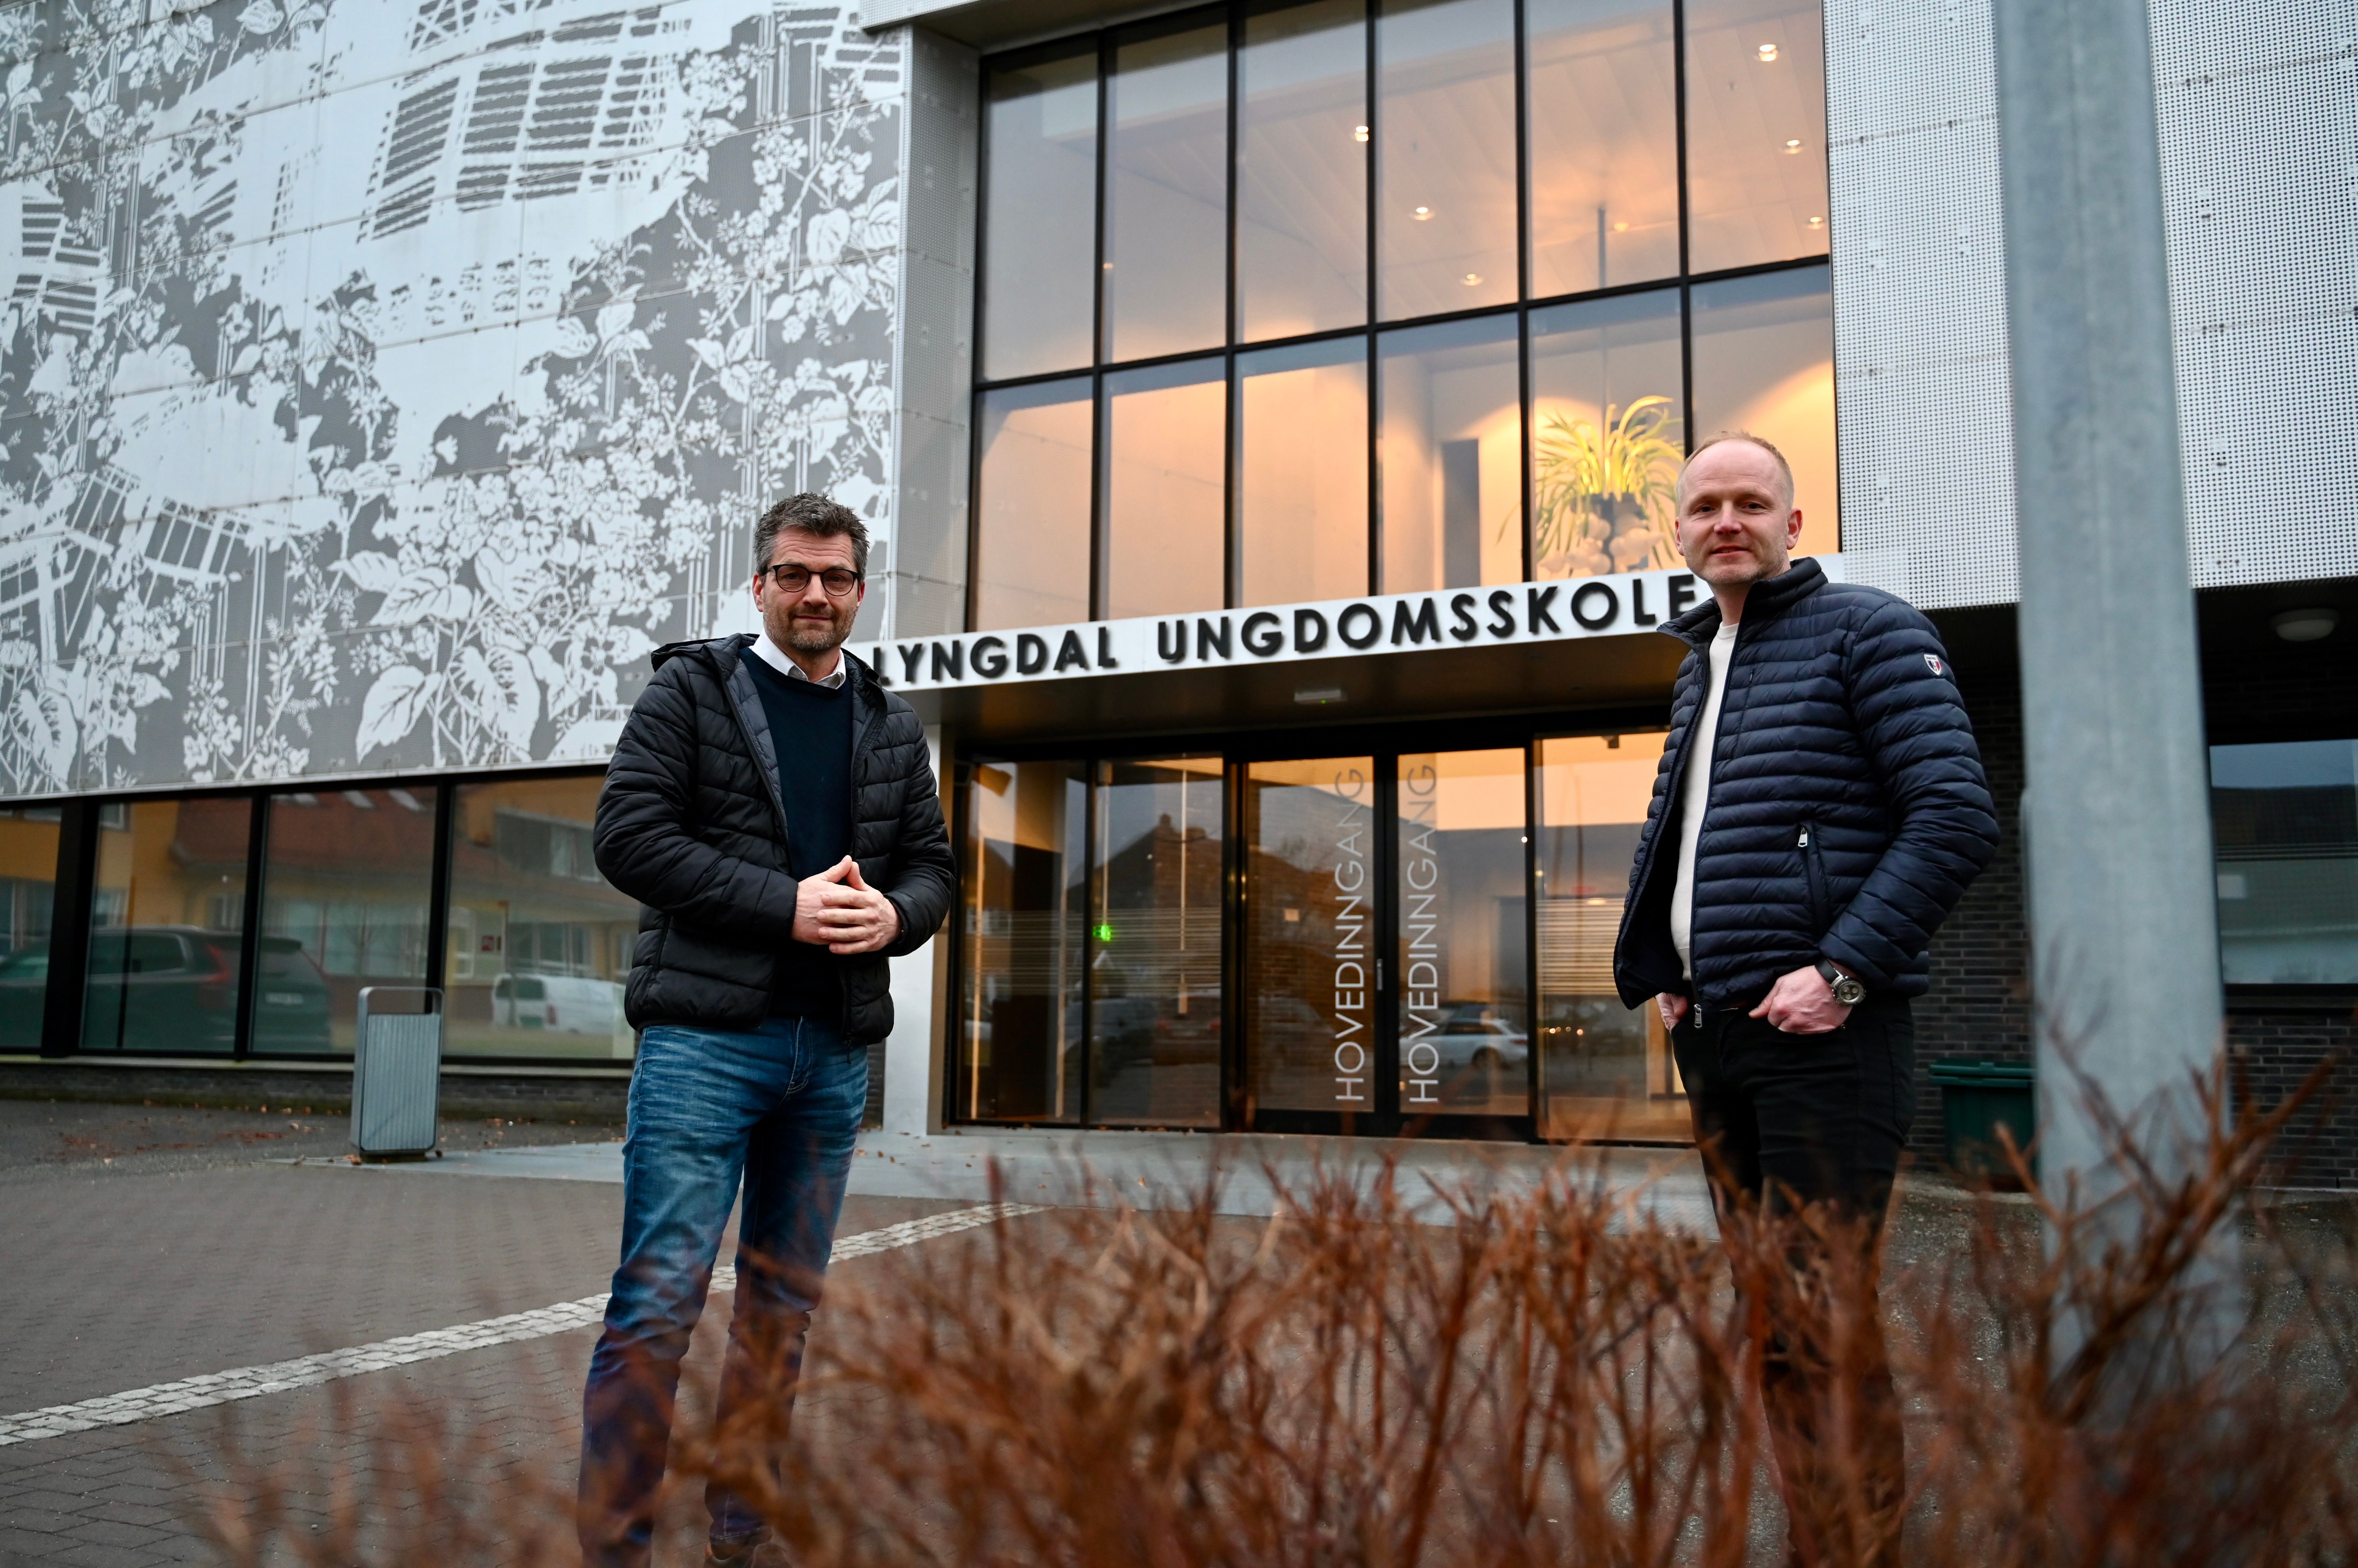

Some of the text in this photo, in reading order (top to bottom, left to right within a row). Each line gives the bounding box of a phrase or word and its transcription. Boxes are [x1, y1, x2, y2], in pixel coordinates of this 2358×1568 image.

[874, 574, 1695, 685] LYNGDAL UNGDOMSSKOLE
[1335, 769, 1364, 1100] HOVEDINNGANG
[1407, 765, 1439, 1102] HOVEDINNGANG
